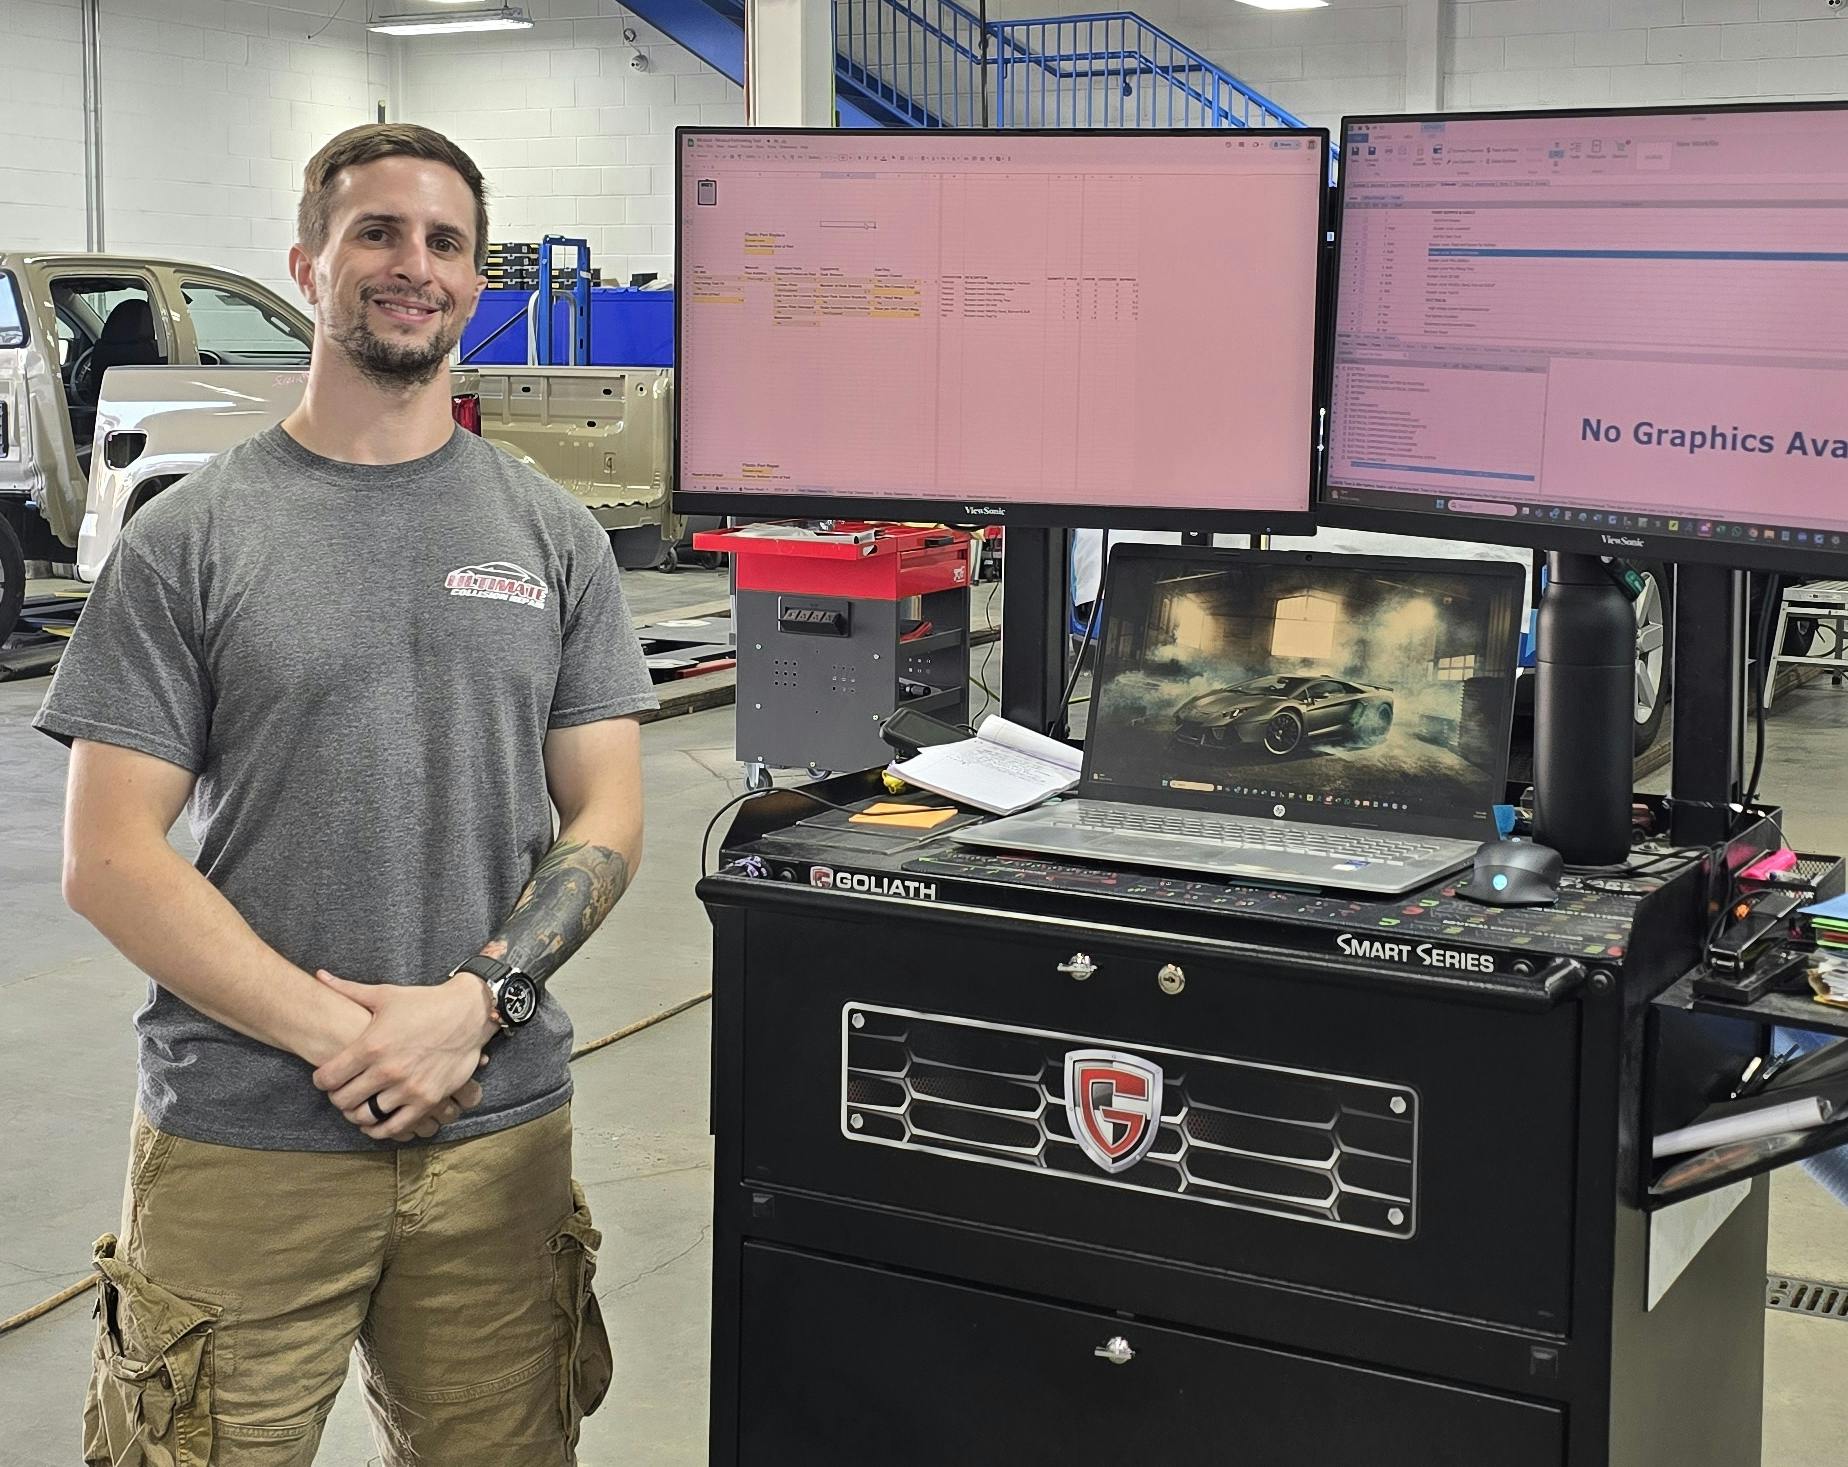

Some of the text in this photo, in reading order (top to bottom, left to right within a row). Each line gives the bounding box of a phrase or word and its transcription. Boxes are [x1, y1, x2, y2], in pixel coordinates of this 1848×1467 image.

[1581, 418, 1848, 459] No Graphics Ava
[965, 506, 1006, 516] ViewSonic
[1601, 534, 1645, 548] ViewSonic
[836, 872, 936, 900] GOLIATH
